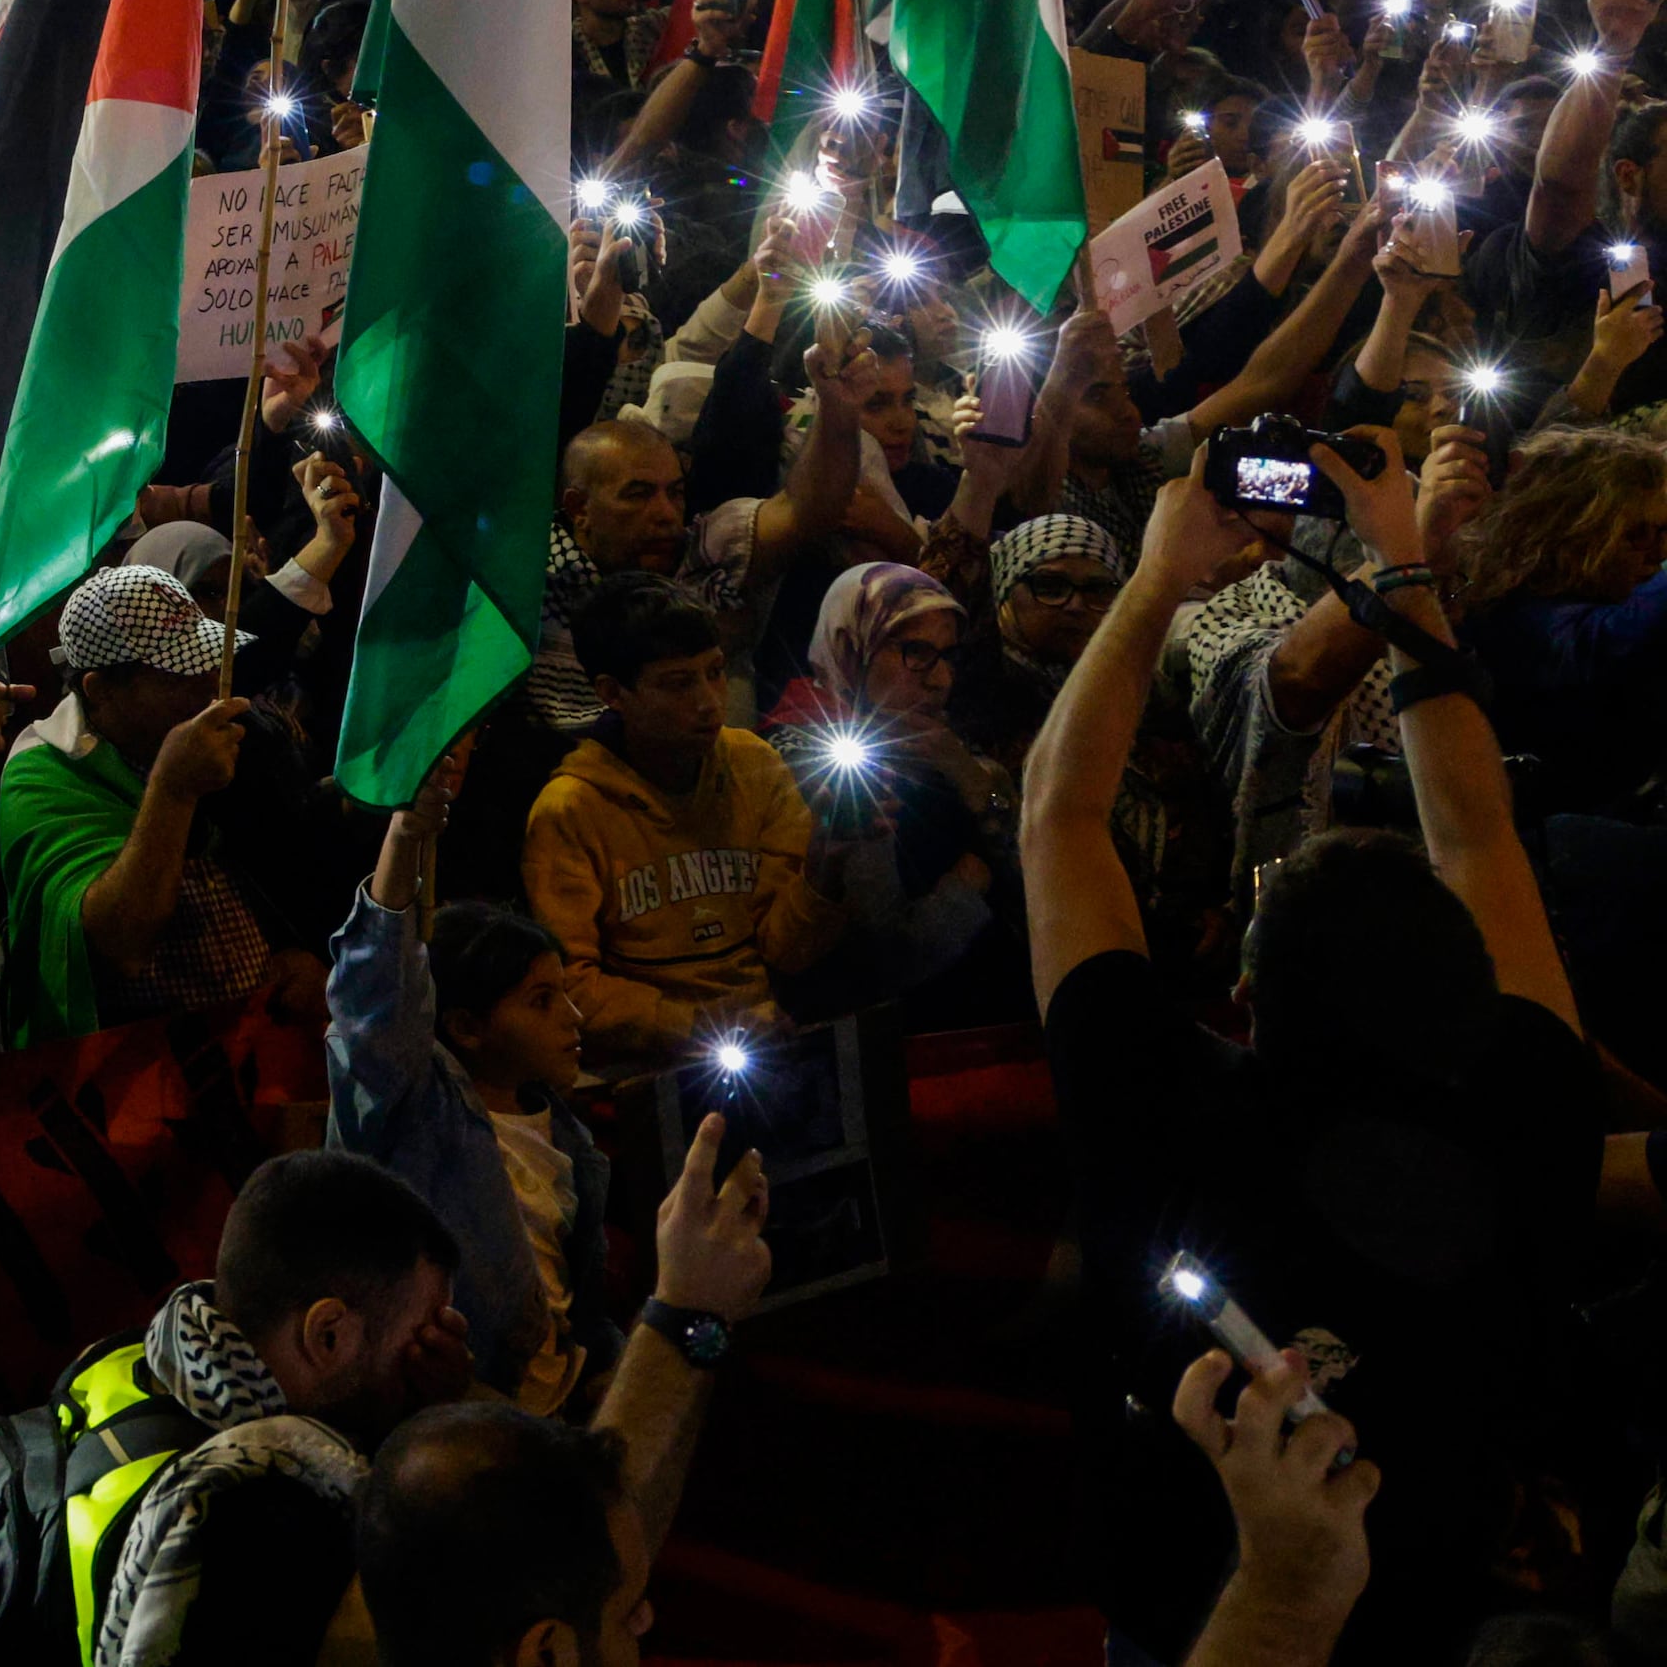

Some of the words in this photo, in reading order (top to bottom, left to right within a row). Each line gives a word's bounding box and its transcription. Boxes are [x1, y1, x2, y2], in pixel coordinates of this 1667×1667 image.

[219, 187, 248, 214] NO
[1157, 192, 1189, 221] FREE
[1143, 196, 1212, 244] PALESTINE
[211, 224, 252, 248] SER
[285, 252, 299, 270] A
[197, 288, 253, 313] SOLO
[267, 284, 310, 304] HACE
[618, 863, 662, 923] LOS
